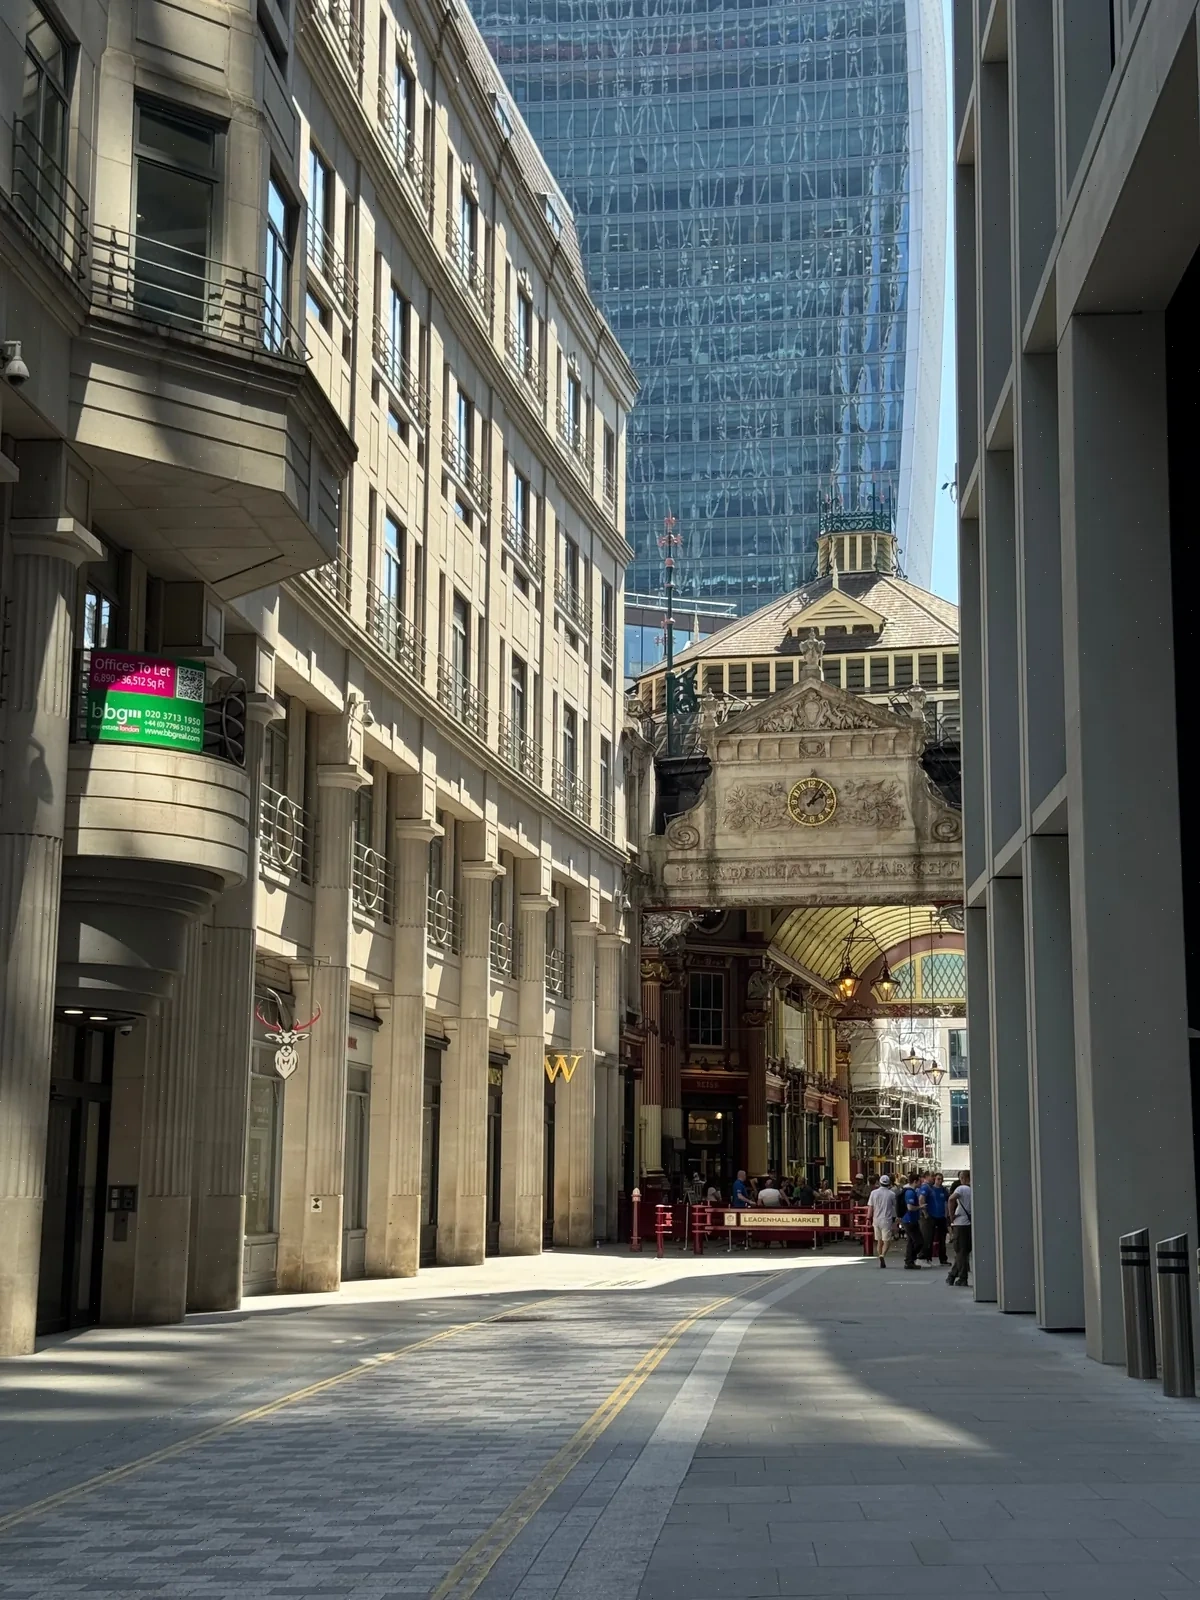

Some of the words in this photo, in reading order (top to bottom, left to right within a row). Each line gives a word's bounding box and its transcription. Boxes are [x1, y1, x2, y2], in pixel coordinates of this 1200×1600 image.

[94, 658, 135, 673] Offices
[138, 662, 151, 674] To
[153, 664, 171, 677] Let
[93, 673, 116, 684] 6,890
[121, 675, 146, 687] 36,512
[147, 678, 157, 690] Sq
[157, 679, 165, 690] Ft
[145, 709, 161, 719] 020
[163, 711, 182, 723] 3713
[184, 716, 201, 727] 1950
[676, 863, 835, 882] LEADENHALL
[852, 859, 960, 879] MARKET
[544, 1054, 584, 1084] W
